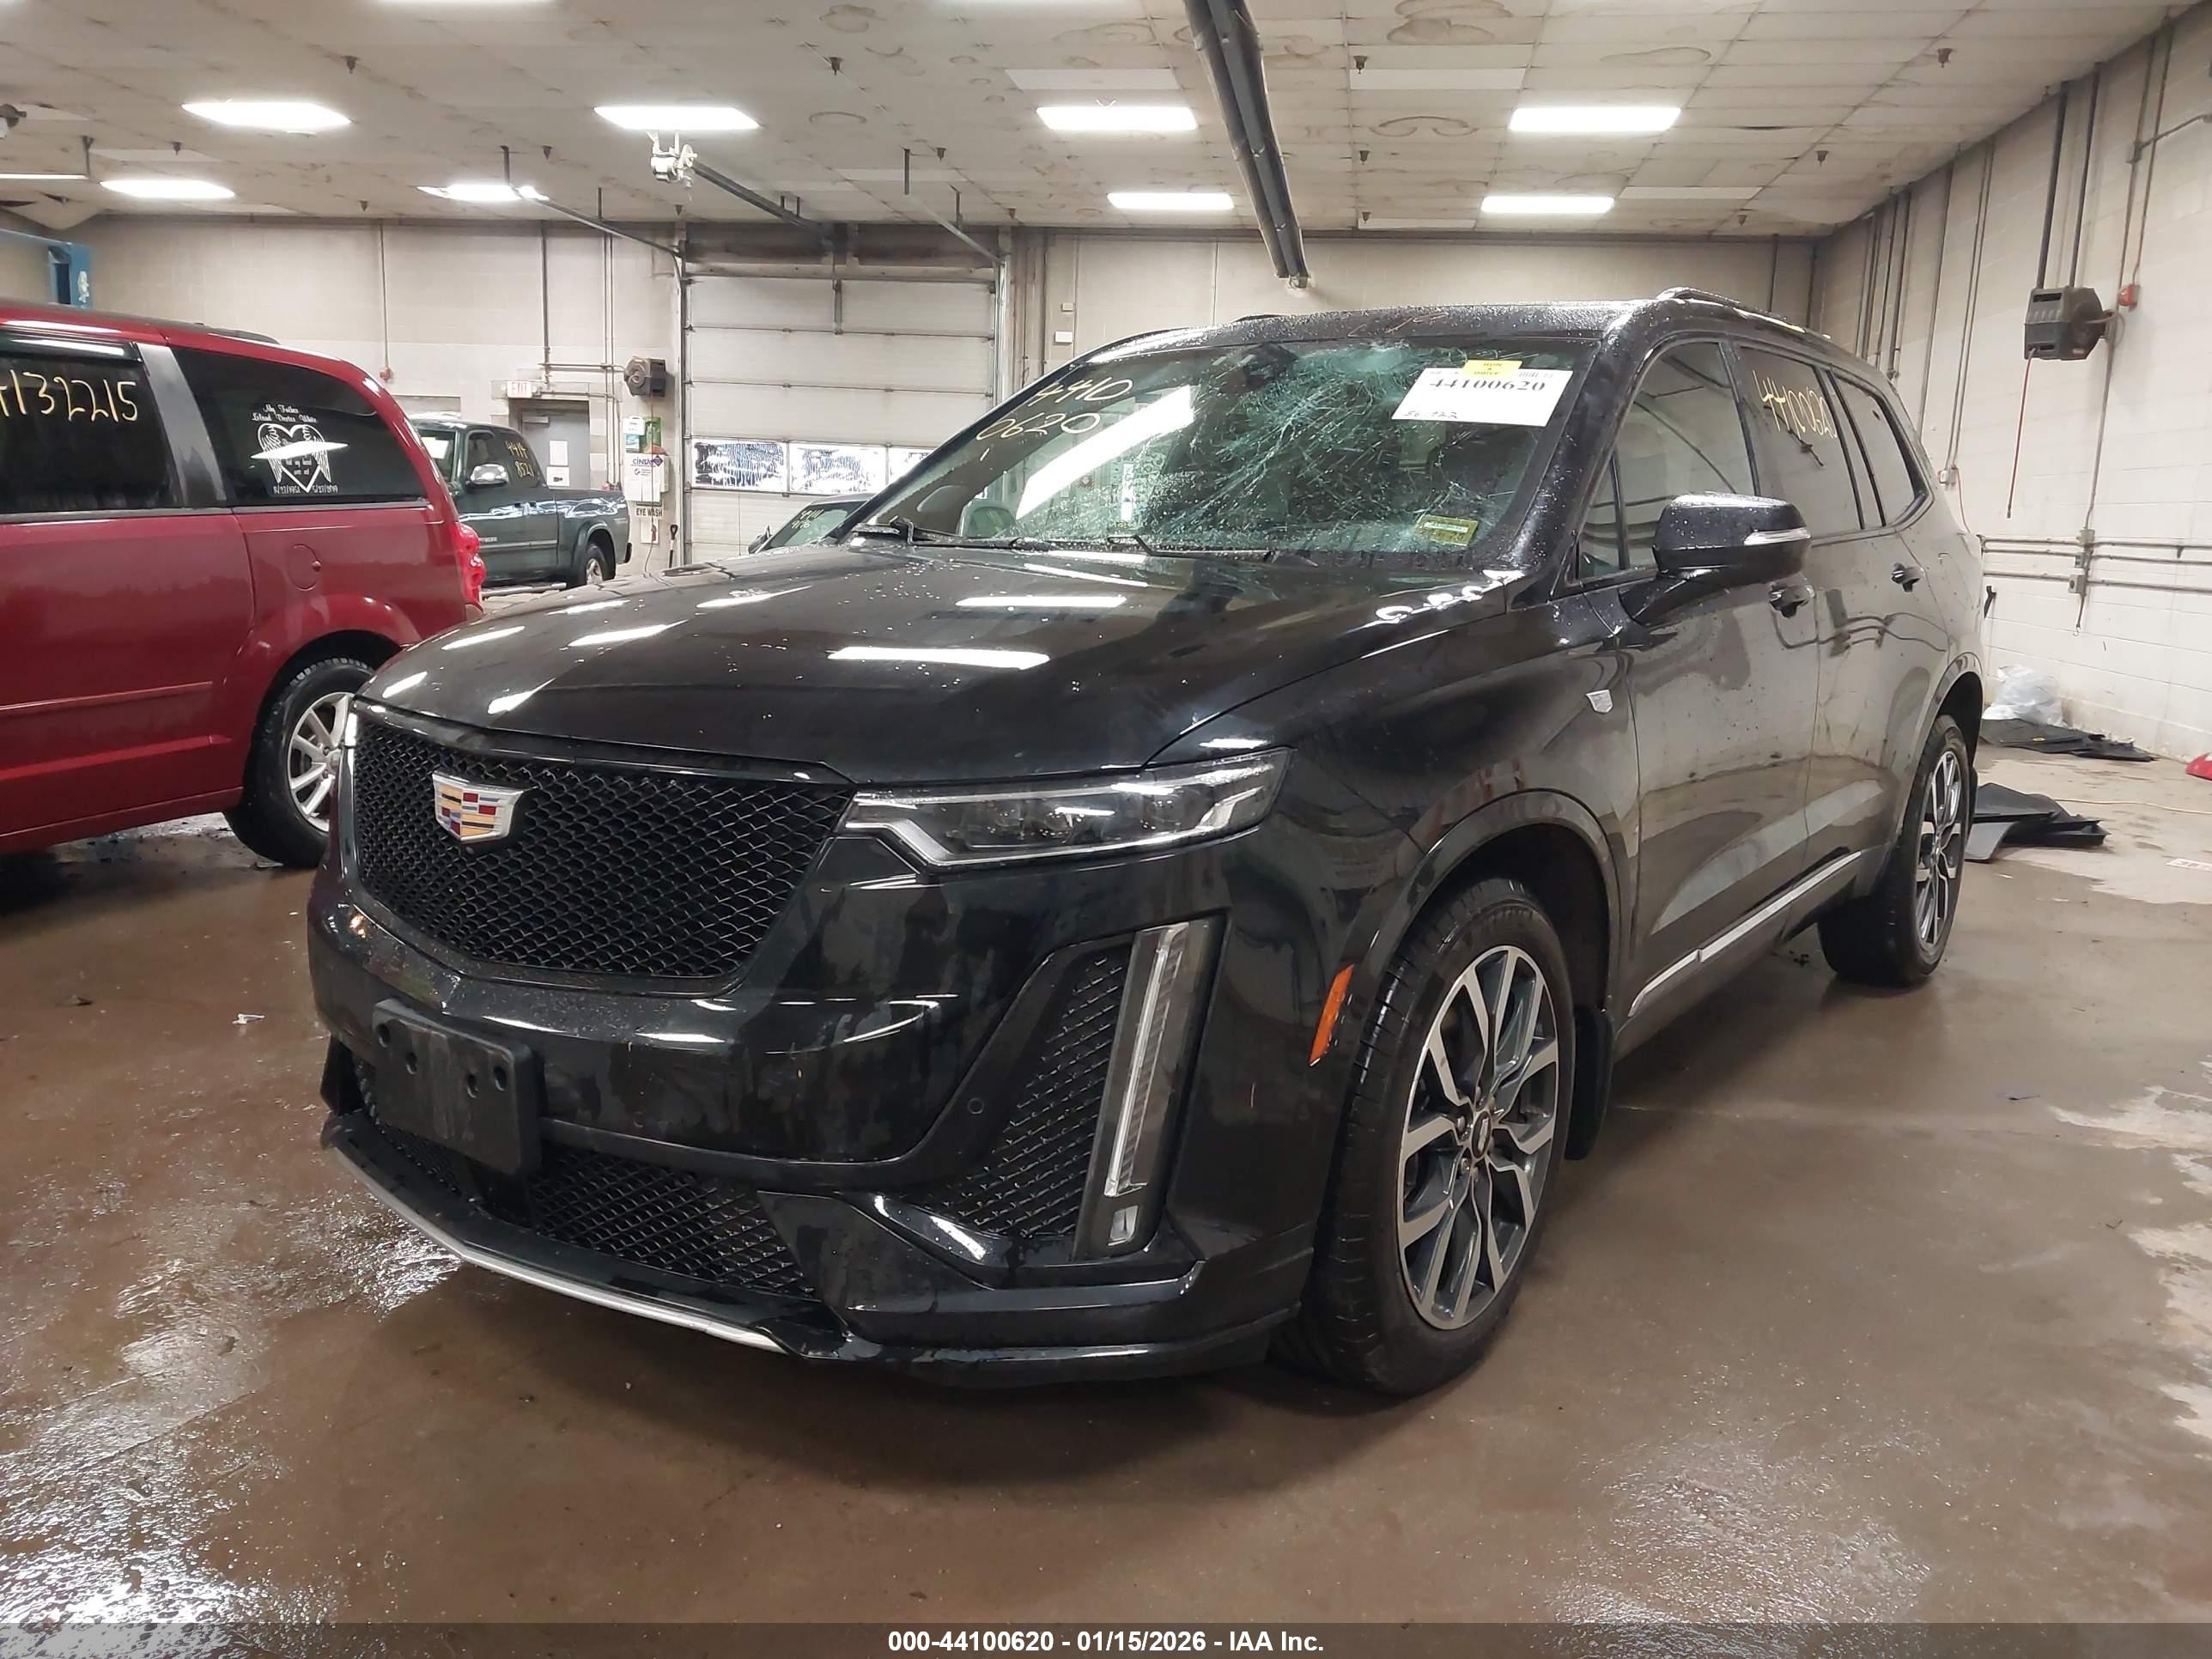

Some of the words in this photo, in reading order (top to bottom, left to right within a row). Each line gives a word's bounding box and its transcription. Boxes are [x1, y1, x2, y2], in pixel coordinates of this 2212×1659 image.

[1027, 377, 1133, 407] 4410
[1429, 379, 1546, 392] 44100620
[975, 412, 1101, 441] 0620
[635, 507, 646, 516] EYE
[647, 507, 663, 517] WASH
